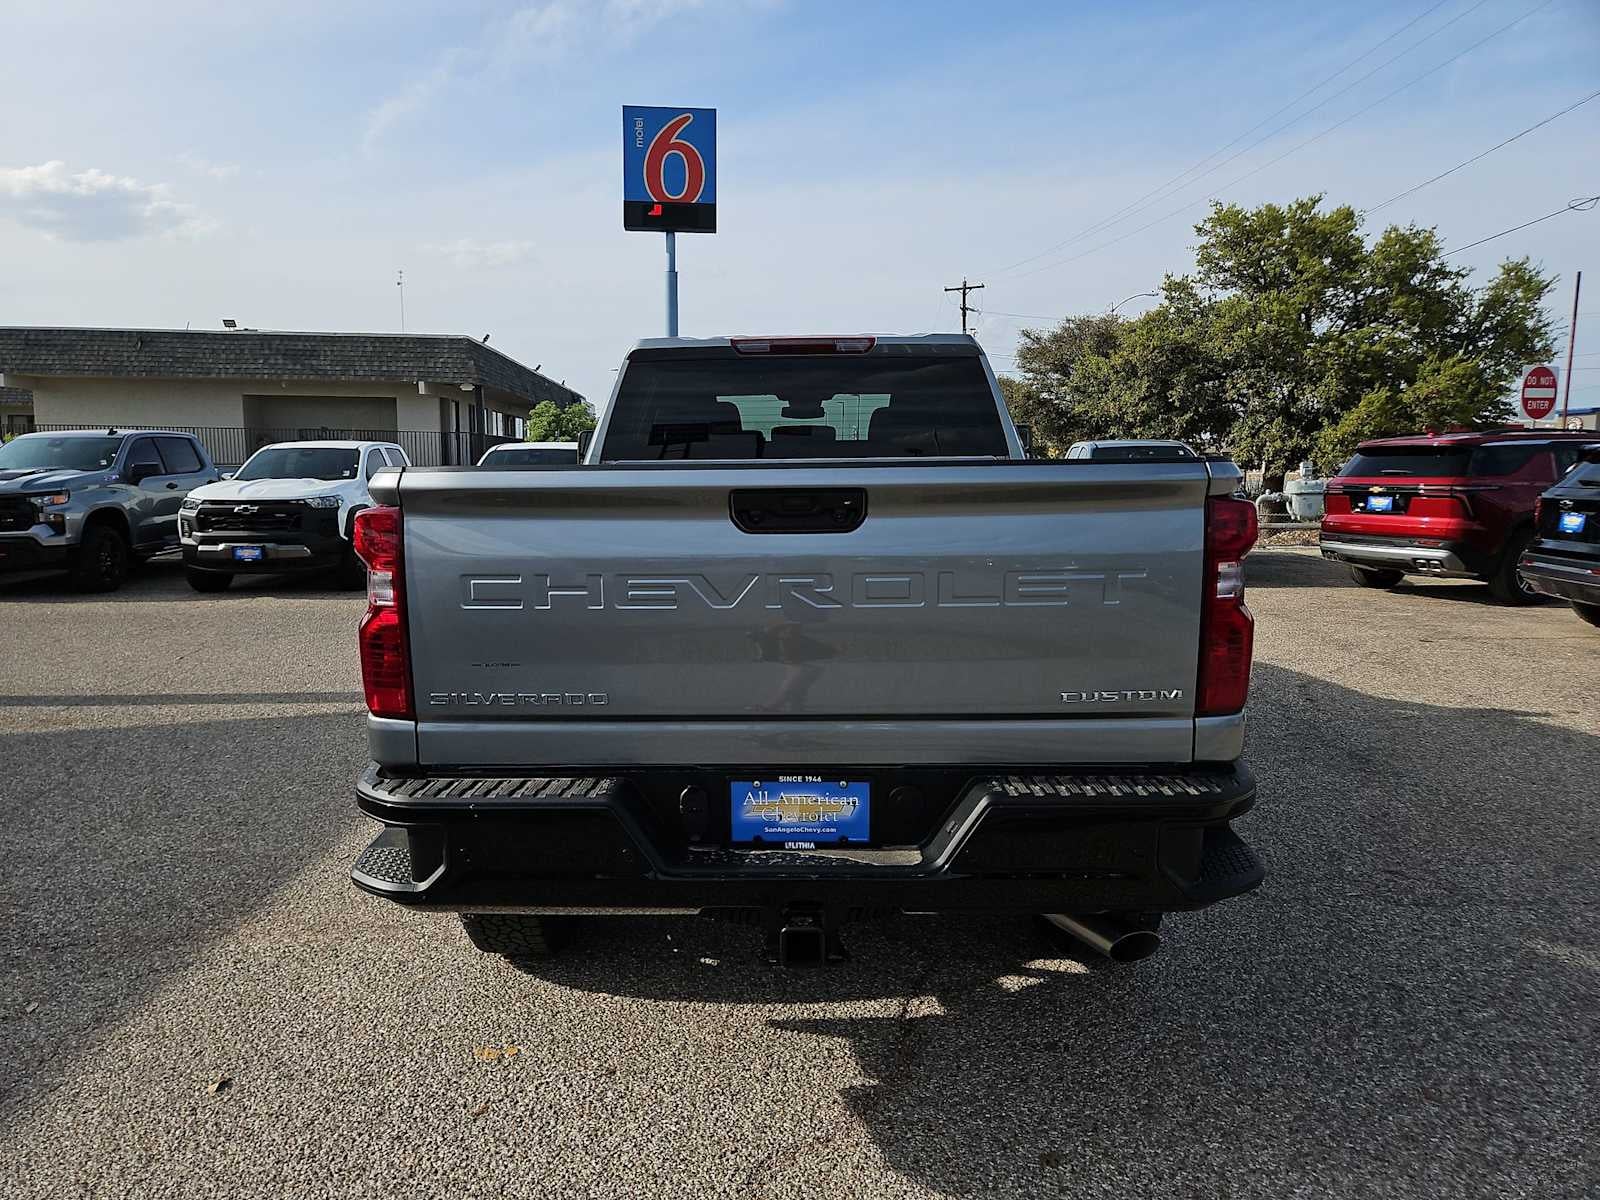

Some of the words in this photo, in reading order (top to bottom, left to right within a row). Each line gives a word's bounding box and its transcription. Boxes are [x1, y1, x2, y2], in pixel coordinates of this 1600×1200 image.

[643, 113, 705, 203] 6
[1527, 376, 1537, 385] DO
[1540, 376, 1554, 385] NOT
[1527, 401, 1549, 409] ENTER
[459, 568, 1149, 610] CHEVROLET
[429, 692, 609, 706] SILVERADO
[1060, 689, 1183, 703] CUSTOM
[778, 775, 802, 783] SINCE
[805, 775, 822, 783] 1946
[743, 791, 769, 805] All
[776, 791, 860, 806] American
[761, 807, 839, 822] Chevrolet
[764, 826, 837, 834] SanAngeloChevy.com
